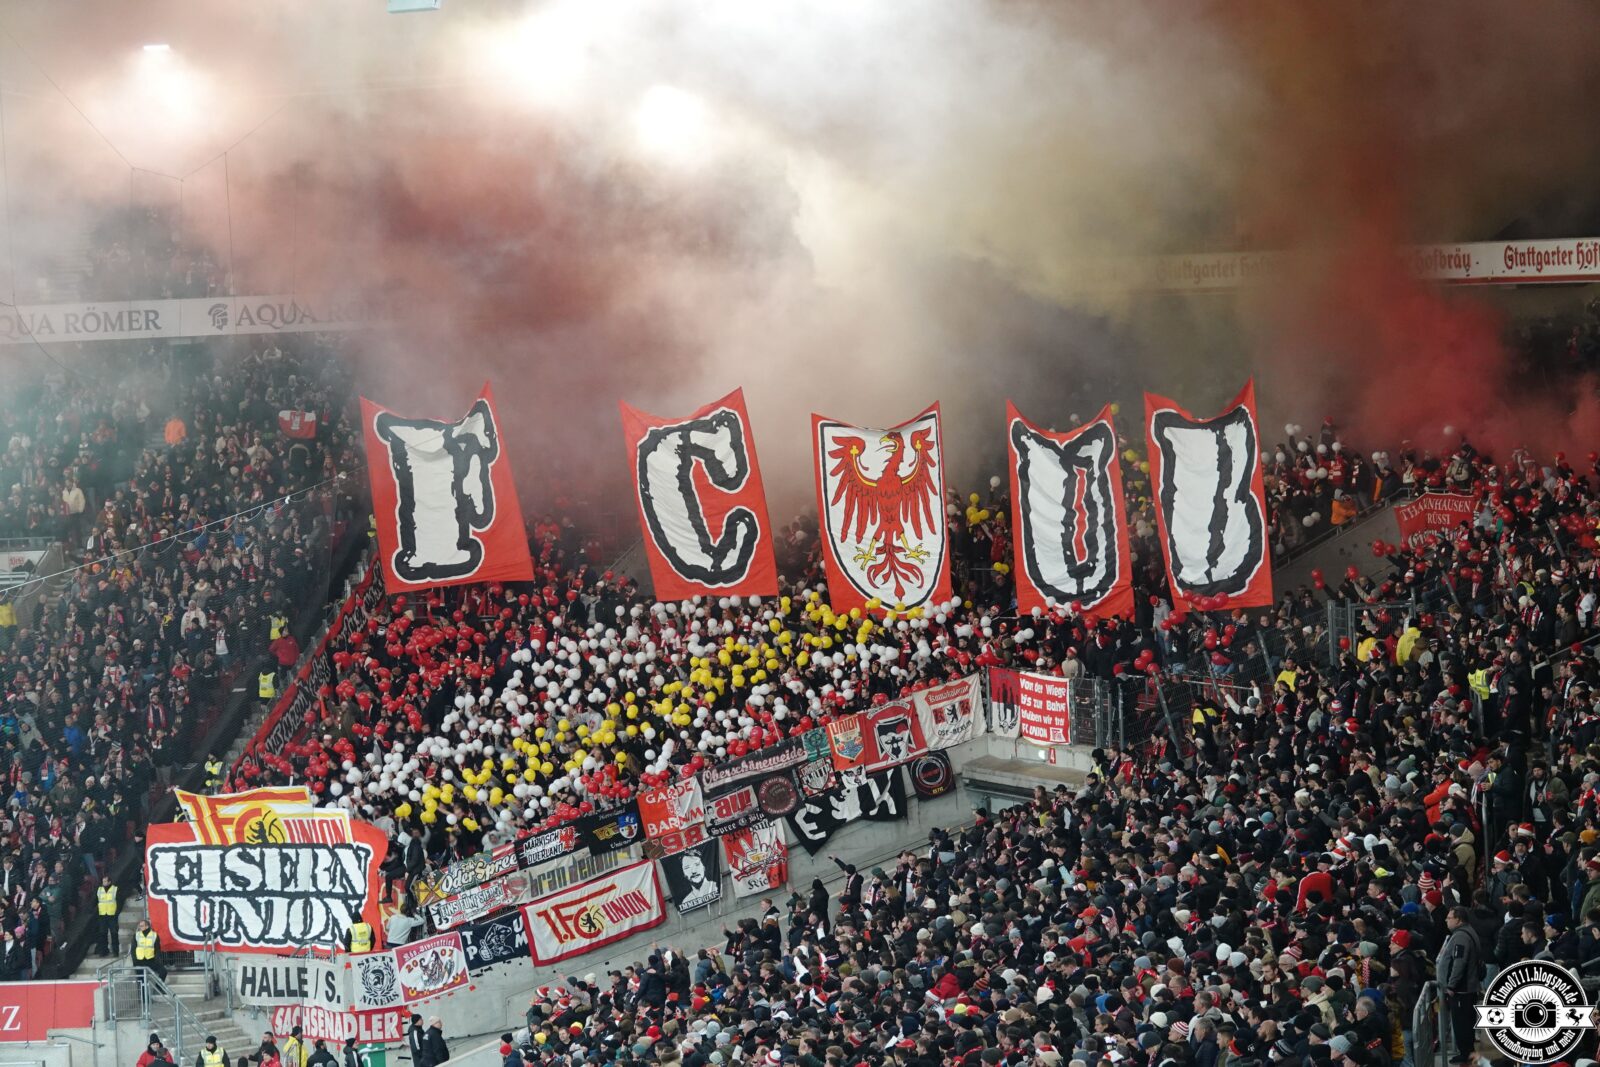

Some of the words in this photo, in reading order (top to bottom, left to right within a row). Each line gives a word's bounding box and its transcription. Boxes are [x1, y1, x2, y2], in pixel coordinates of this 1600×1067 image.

[1504, 245, 1573, 272] Stuttgarter
[1576, 241, 1600, 270] Hof
[64, 306, 162, 334] RÖMER
[236, 302, 317, 329] AQUA
[1019, 678, 1033, 691] Von
[1046, 684, 1066, 698] Wiege
[1020, 694, 1031, 706] bis
[702, 745, 803, 784] Oberschöneweide
[645, 781, 694, 804] GARDE
[283, 818, 347, 844] UNION
[647, 806, 704, 836] BARNIM
[152, 845, 371, 898] EISERN
[169, 894, 362, 944] UNION
[601, 890, 652, 924] UNION
[357, 955, 394, 968] SIXTY
[241, 966, 308, 998] HALLE
[359, 991, 399, 1006] NINERS
[275, 1007, 400, 1042] SACHSENADLER
